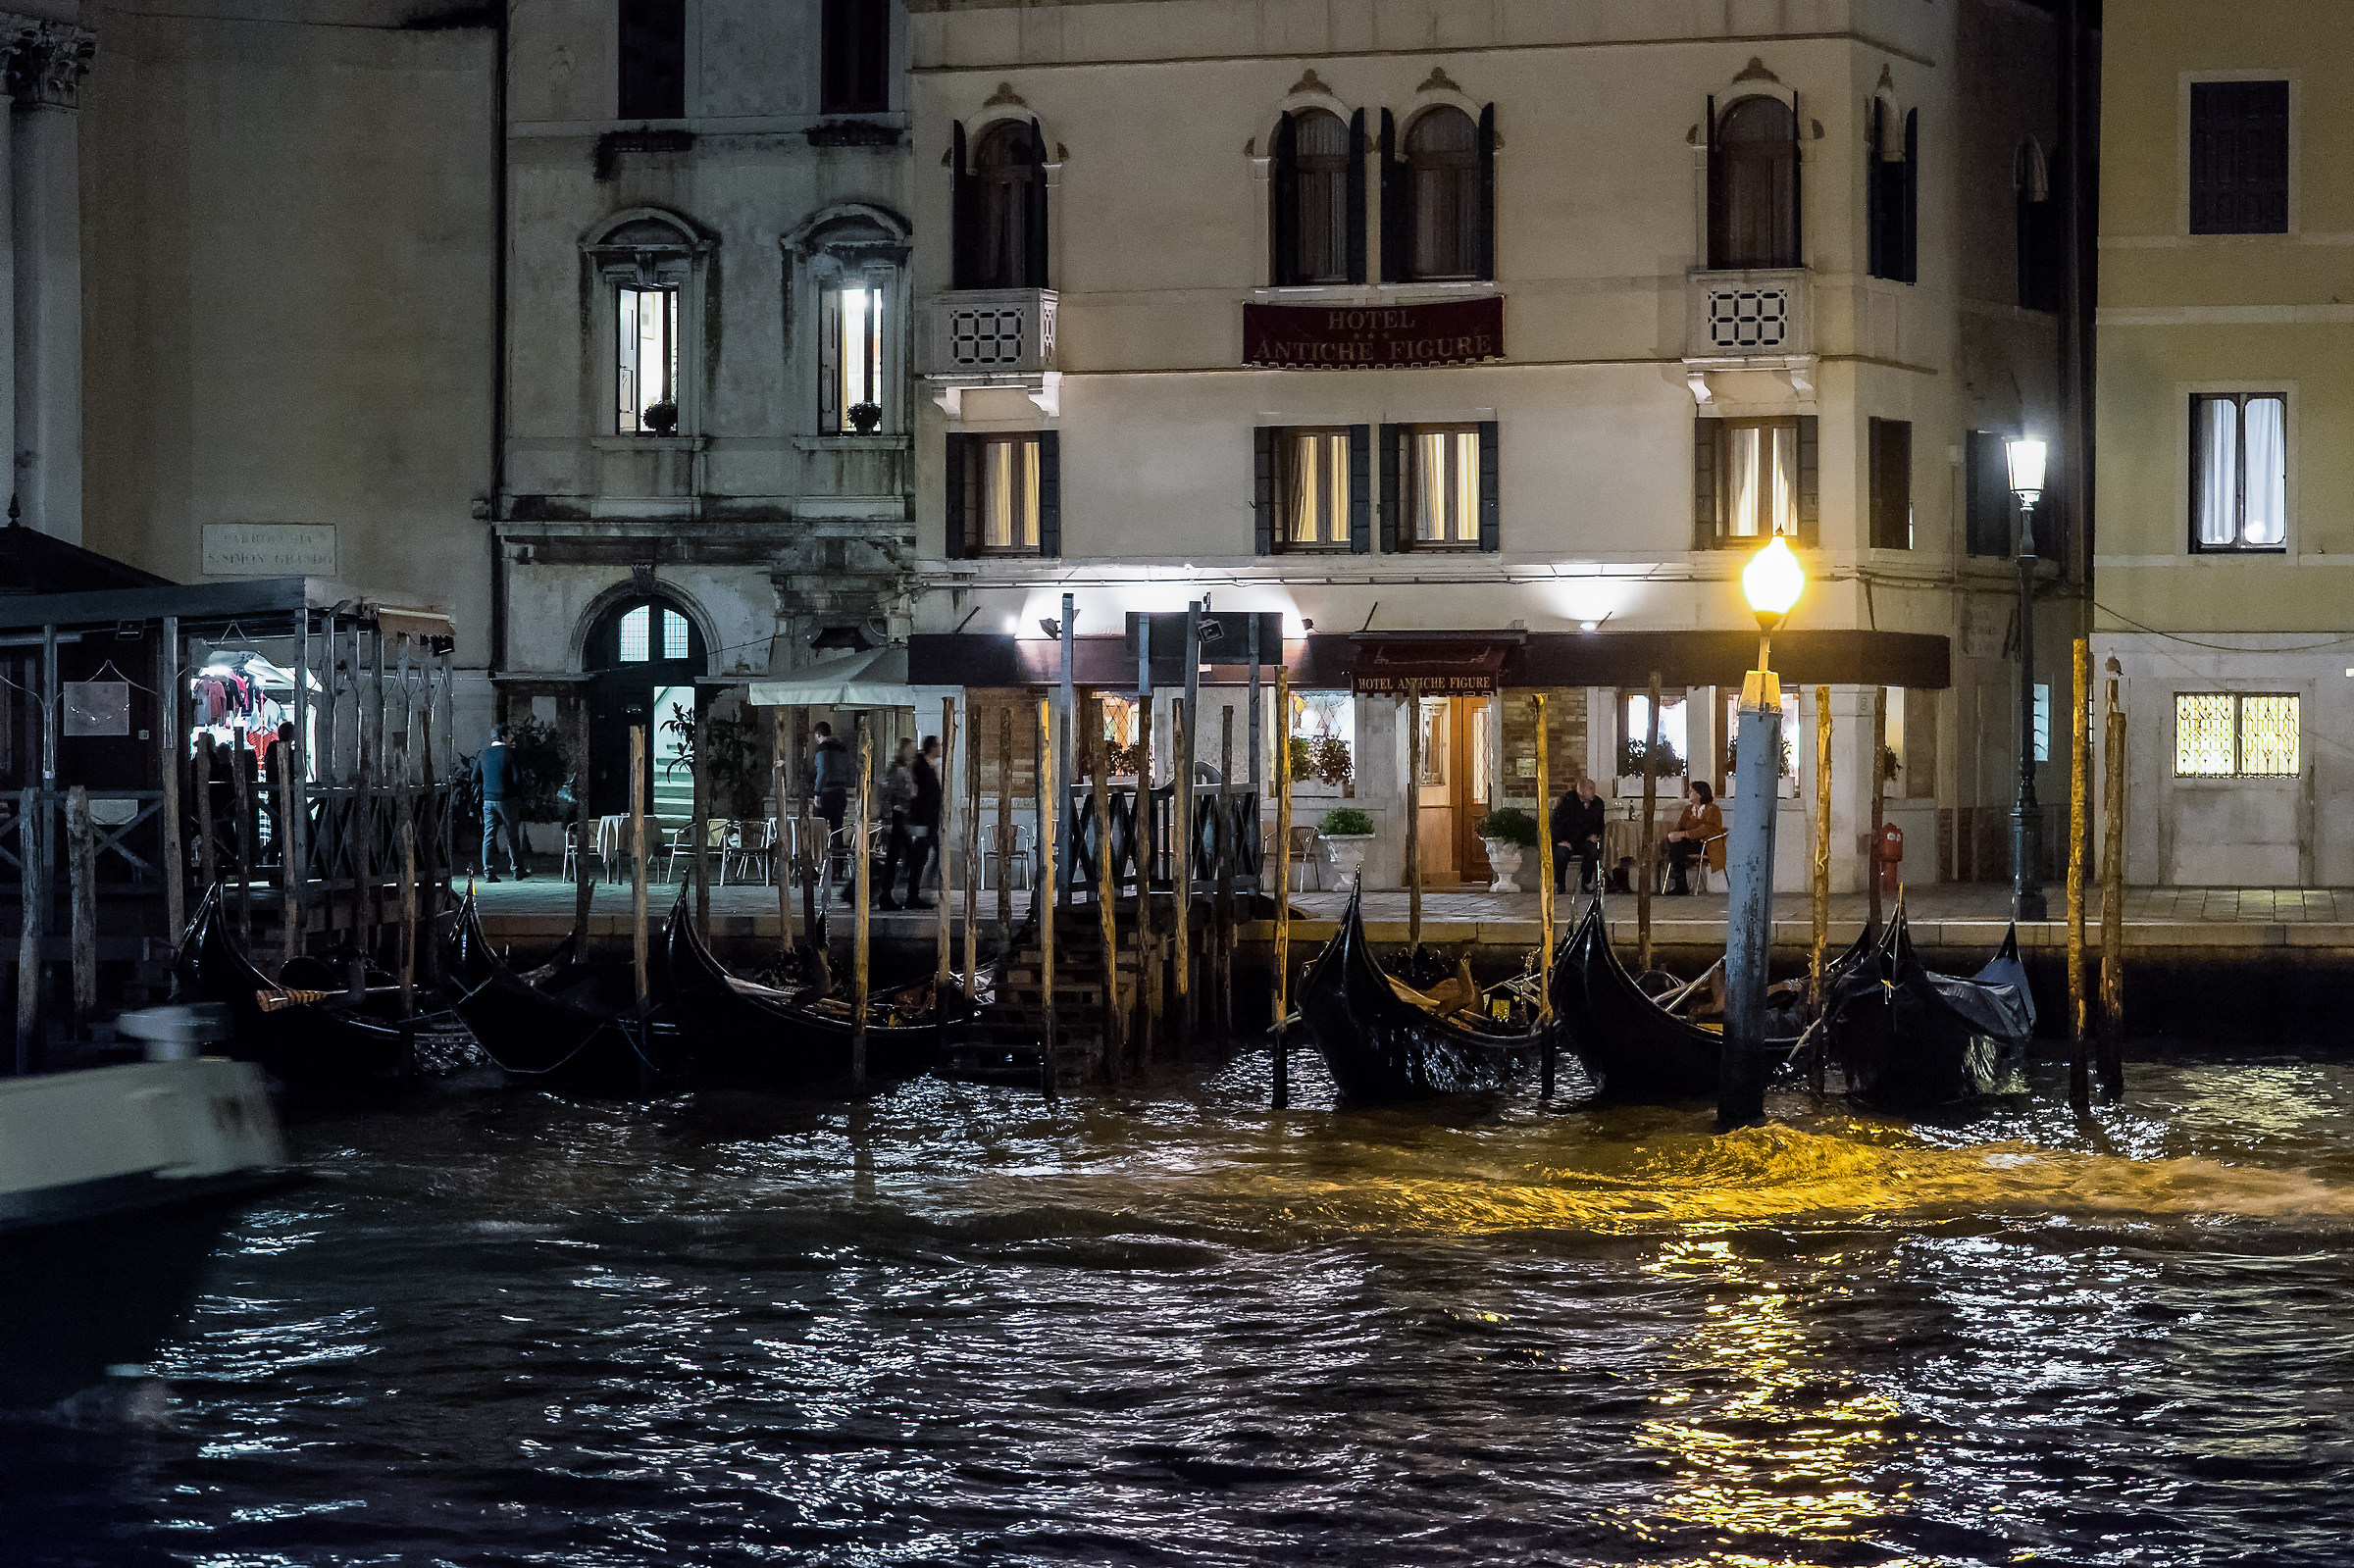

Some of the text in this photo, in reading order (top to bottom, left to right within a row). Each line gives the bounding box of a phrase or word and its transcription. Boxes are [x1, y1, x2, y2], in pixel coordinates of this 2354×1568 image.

[1327, 310, 1415, 330] HOTEL
[1254, 334, 1492, 361] ANTICHE FIGURE
[1358, 678, 1393, 689] HOTEL
[1450, 677, 1490, 688] FIGURE
